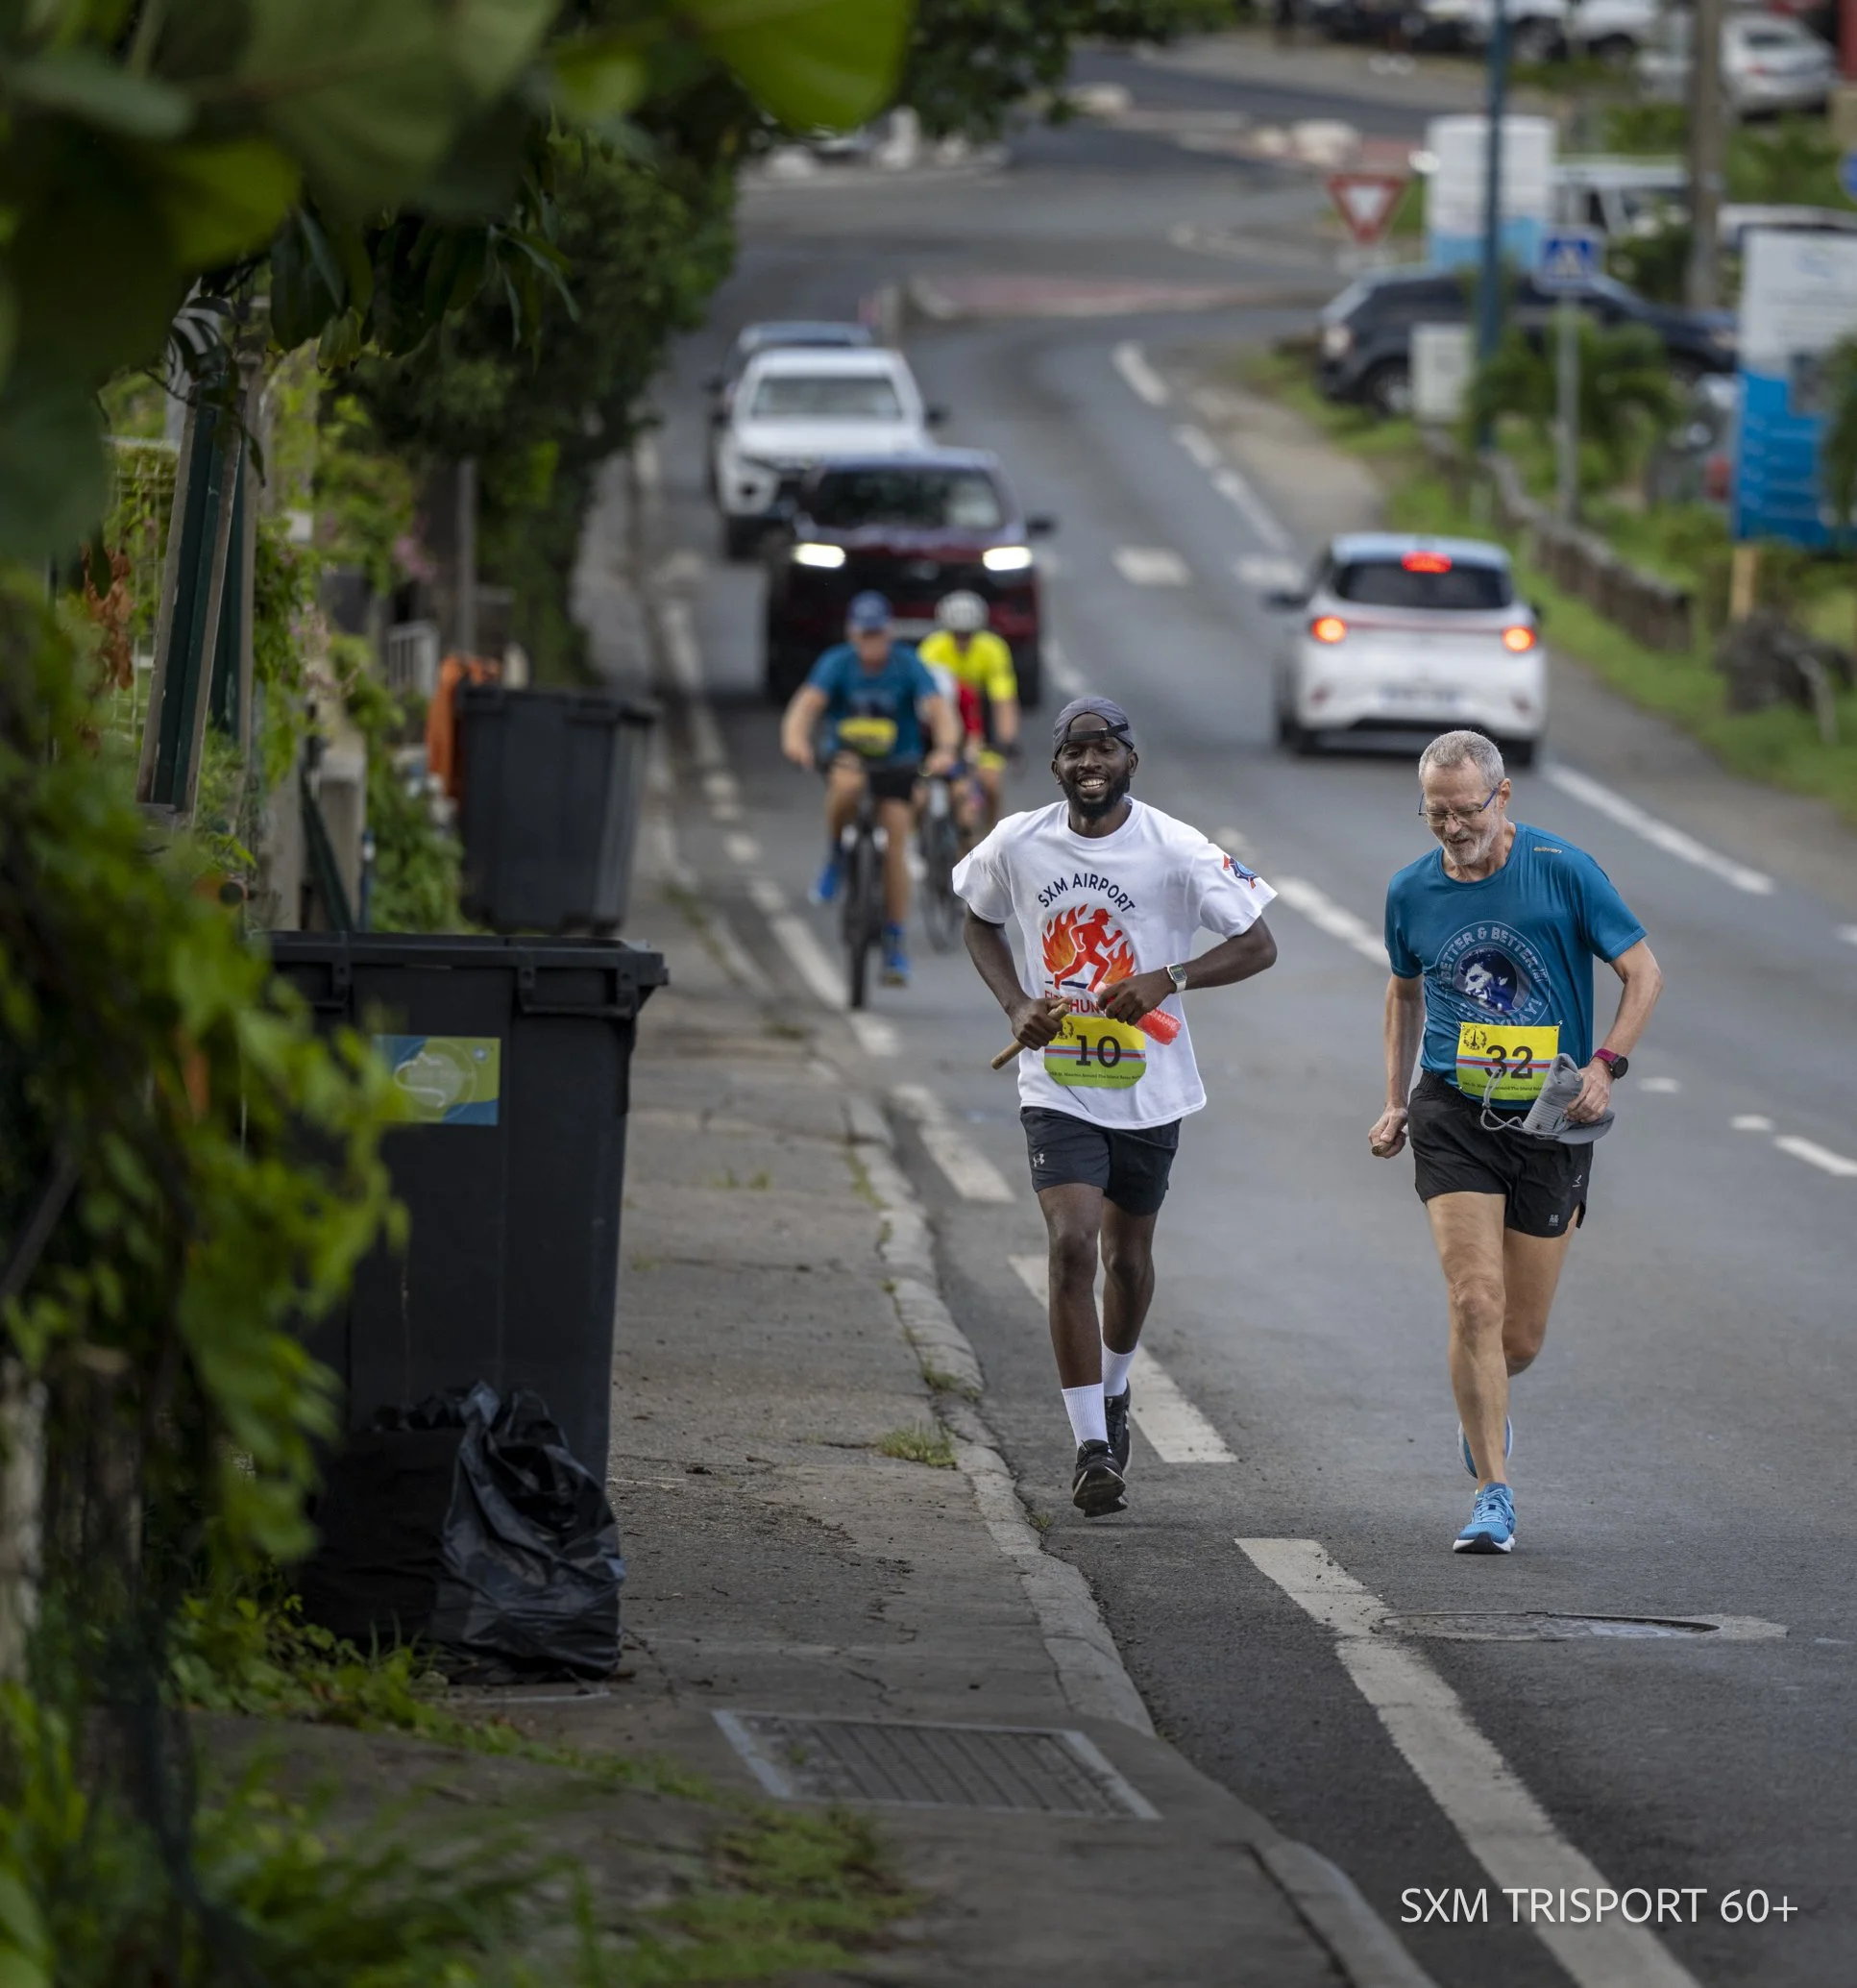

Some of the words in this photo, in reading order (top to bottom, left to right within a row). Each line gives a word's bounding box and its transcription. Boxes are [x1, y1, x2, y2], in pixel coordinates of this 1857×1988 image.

[1038, 877, 1068, 908] SXM
[1072, 872, 1136, 912] AIRPORT
[1440, 931, 1476, 981] BETTER
[1491, 926, 1538, 969] BETTER
[1068, 998, 1106, 1015] HUN
[1075, 1034, 1121, 1068] 10
[1484, 1044, 1533, 1079] 32
